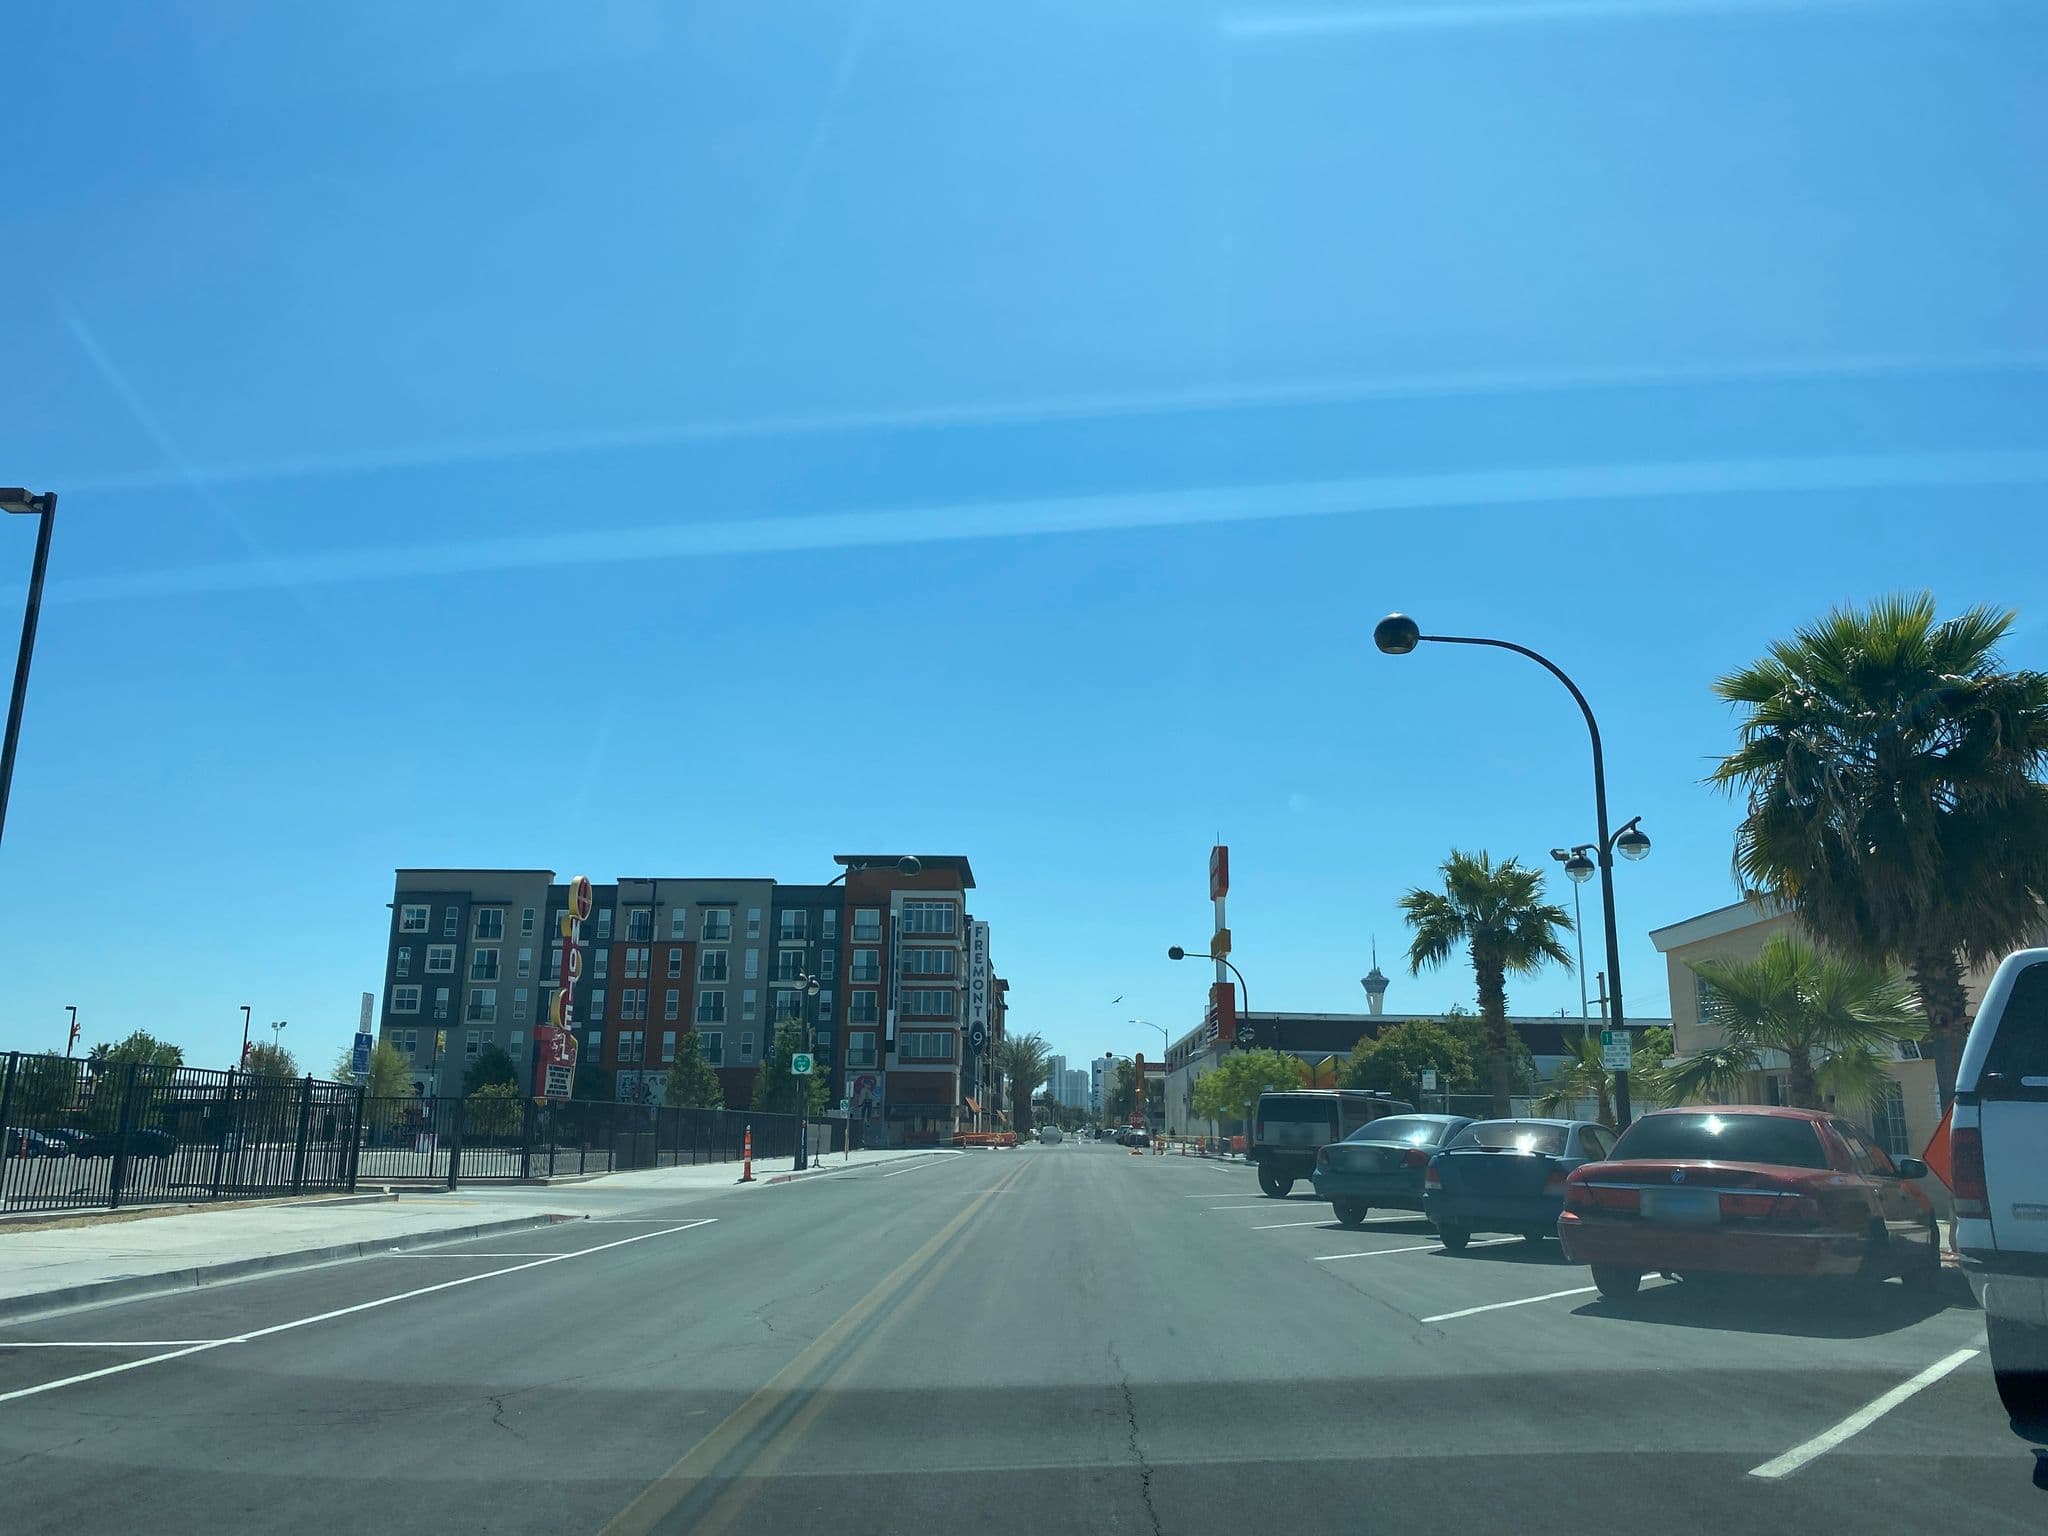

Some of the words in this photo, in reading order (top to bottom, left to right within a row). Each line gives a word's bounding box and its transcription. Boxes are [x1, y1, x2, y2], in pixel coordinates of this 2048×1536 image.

[561, 918, 581, 1061] MOTEL
[972, 926, 985, 1018] FREMONT
[972, 1030, 984, 1046] 9
